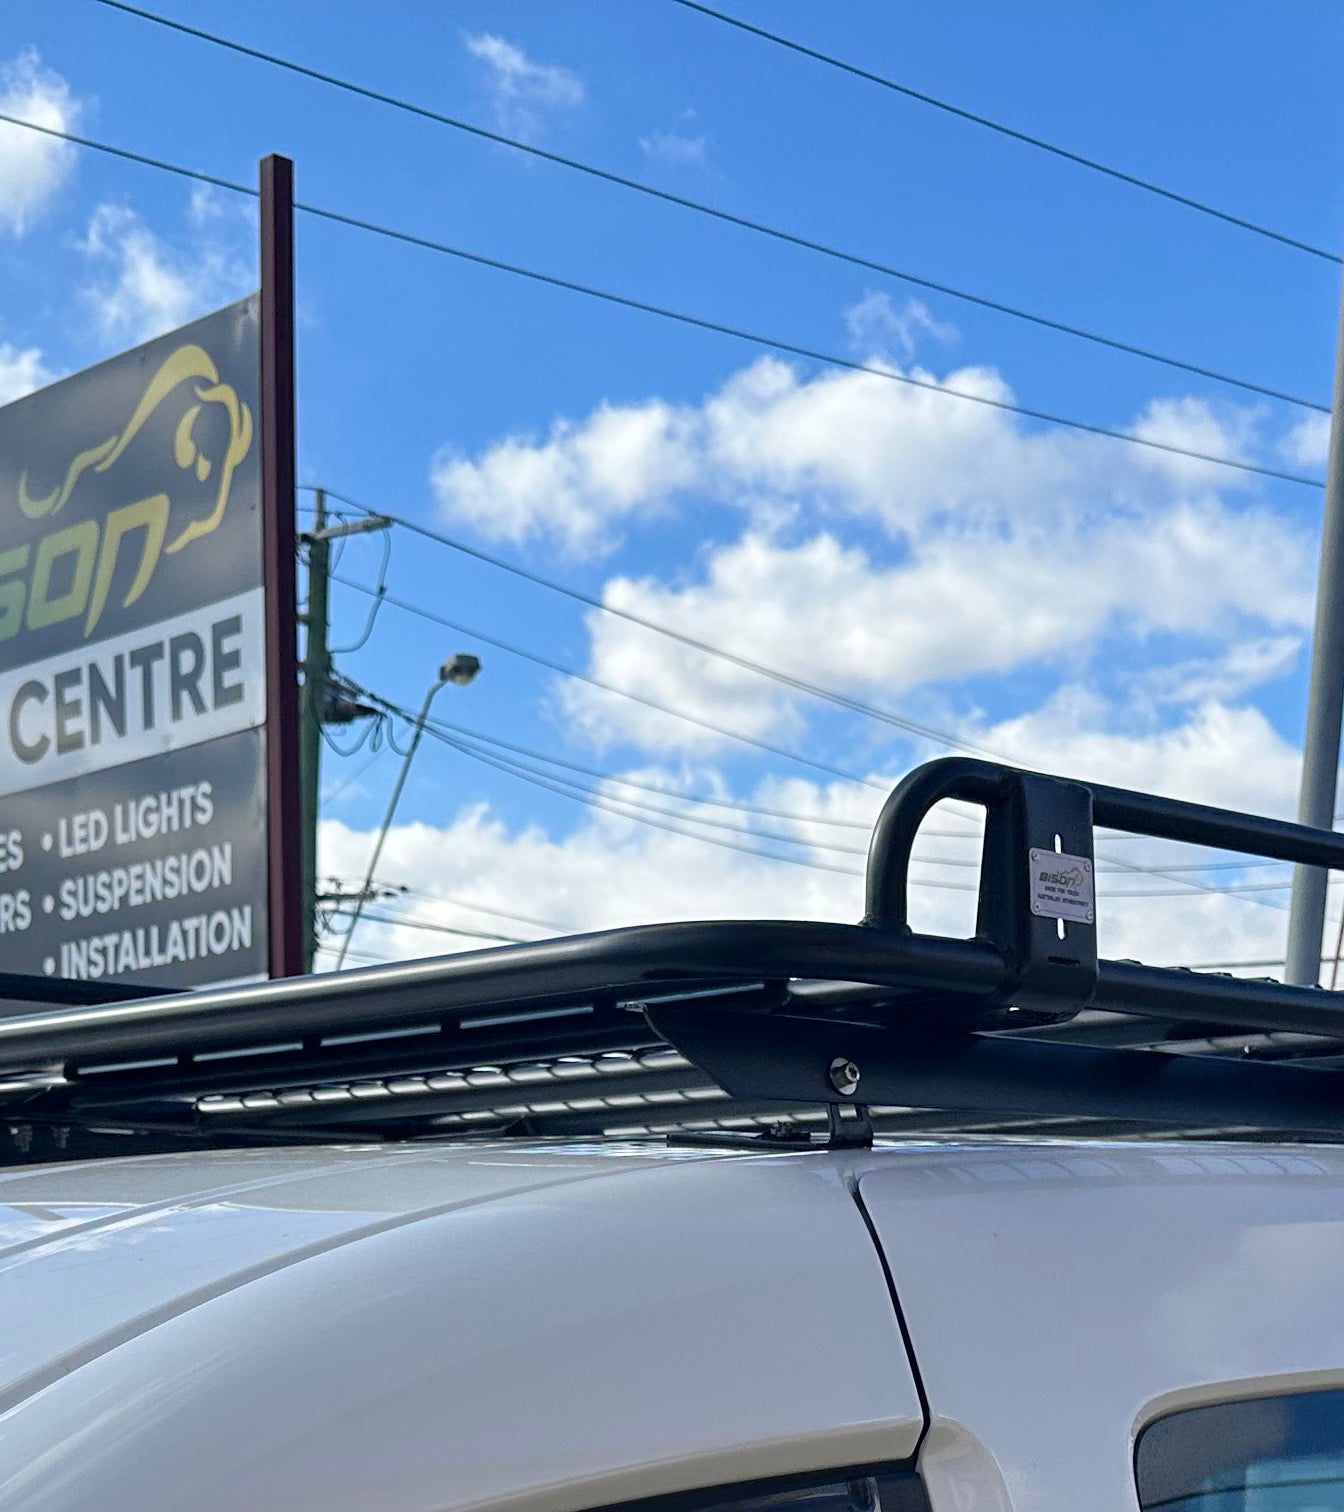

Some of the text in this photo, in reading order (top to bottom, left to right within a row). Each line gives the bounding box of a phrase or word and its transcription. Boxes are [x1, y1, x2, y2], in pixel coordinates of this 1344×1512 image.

[9, 614, 245, 766] CENTRE
[59, 781, 214, 857] LED LIGHTS
[59, 843, 234, 920] SUSPENSION
[59, 905, 253, 981] INSTALLATION
